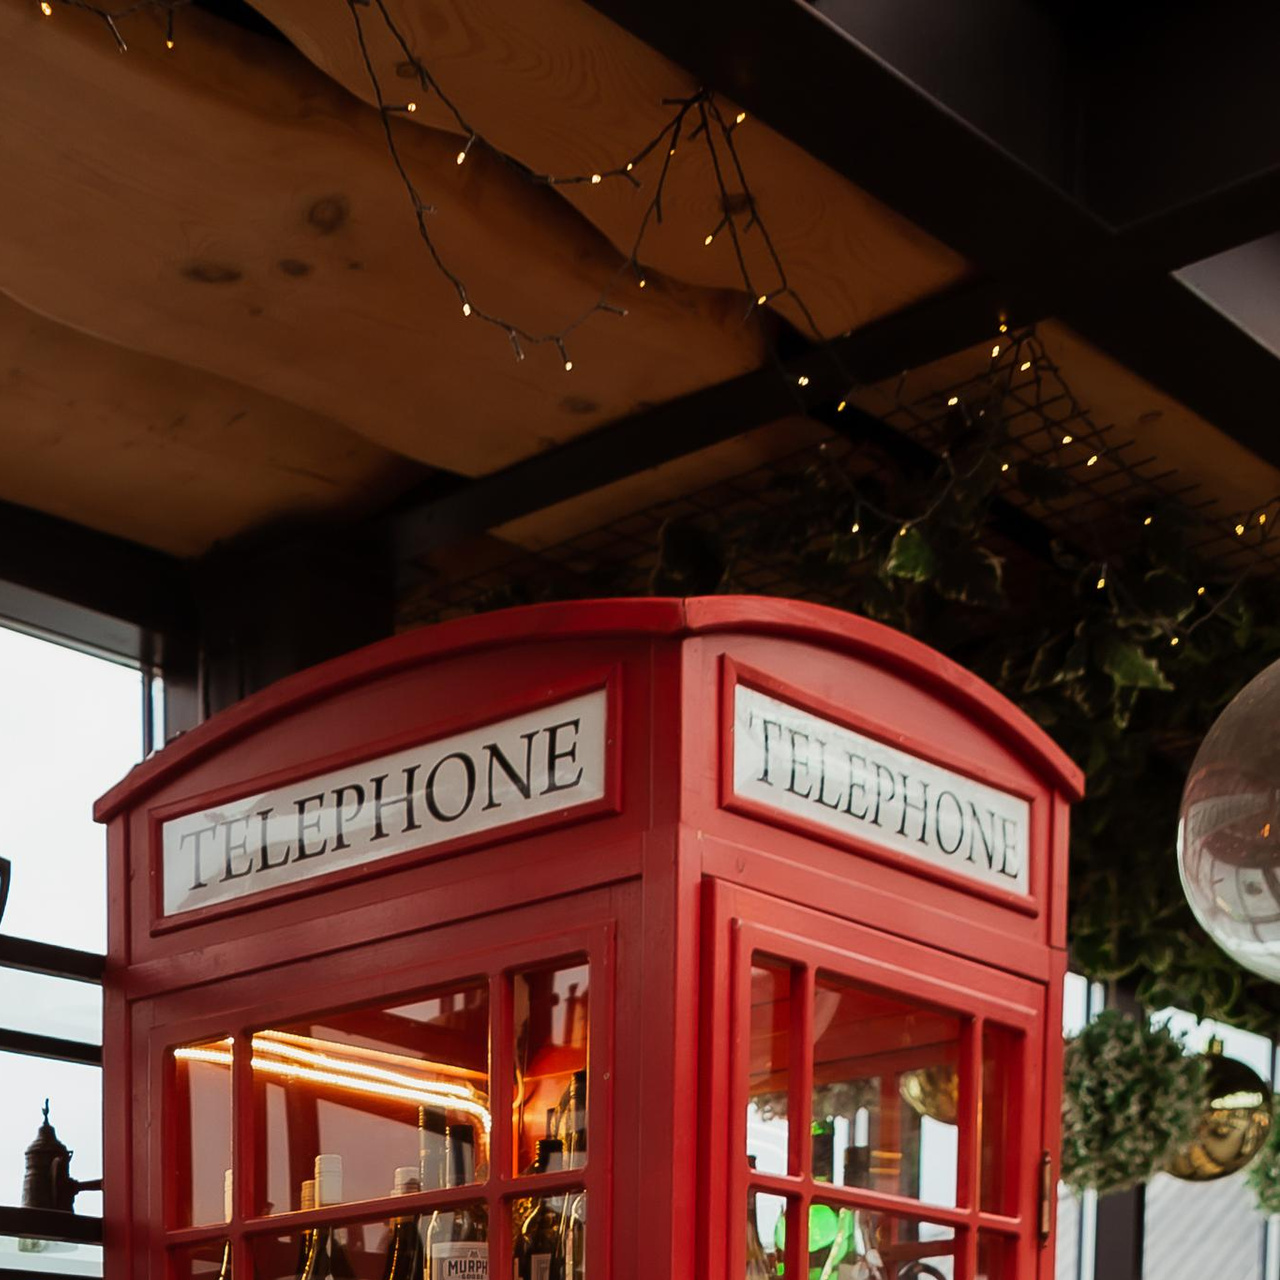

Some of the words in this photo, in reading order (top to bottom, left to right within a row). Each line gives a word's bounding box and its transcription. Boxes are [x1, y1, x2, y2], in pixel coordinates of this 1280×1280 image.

[179, 717, 584, 892] TELEPHONE
[749, 709, 1019, 880] TELEPHONE
[448, 1259, 488, 1277] MURPH
